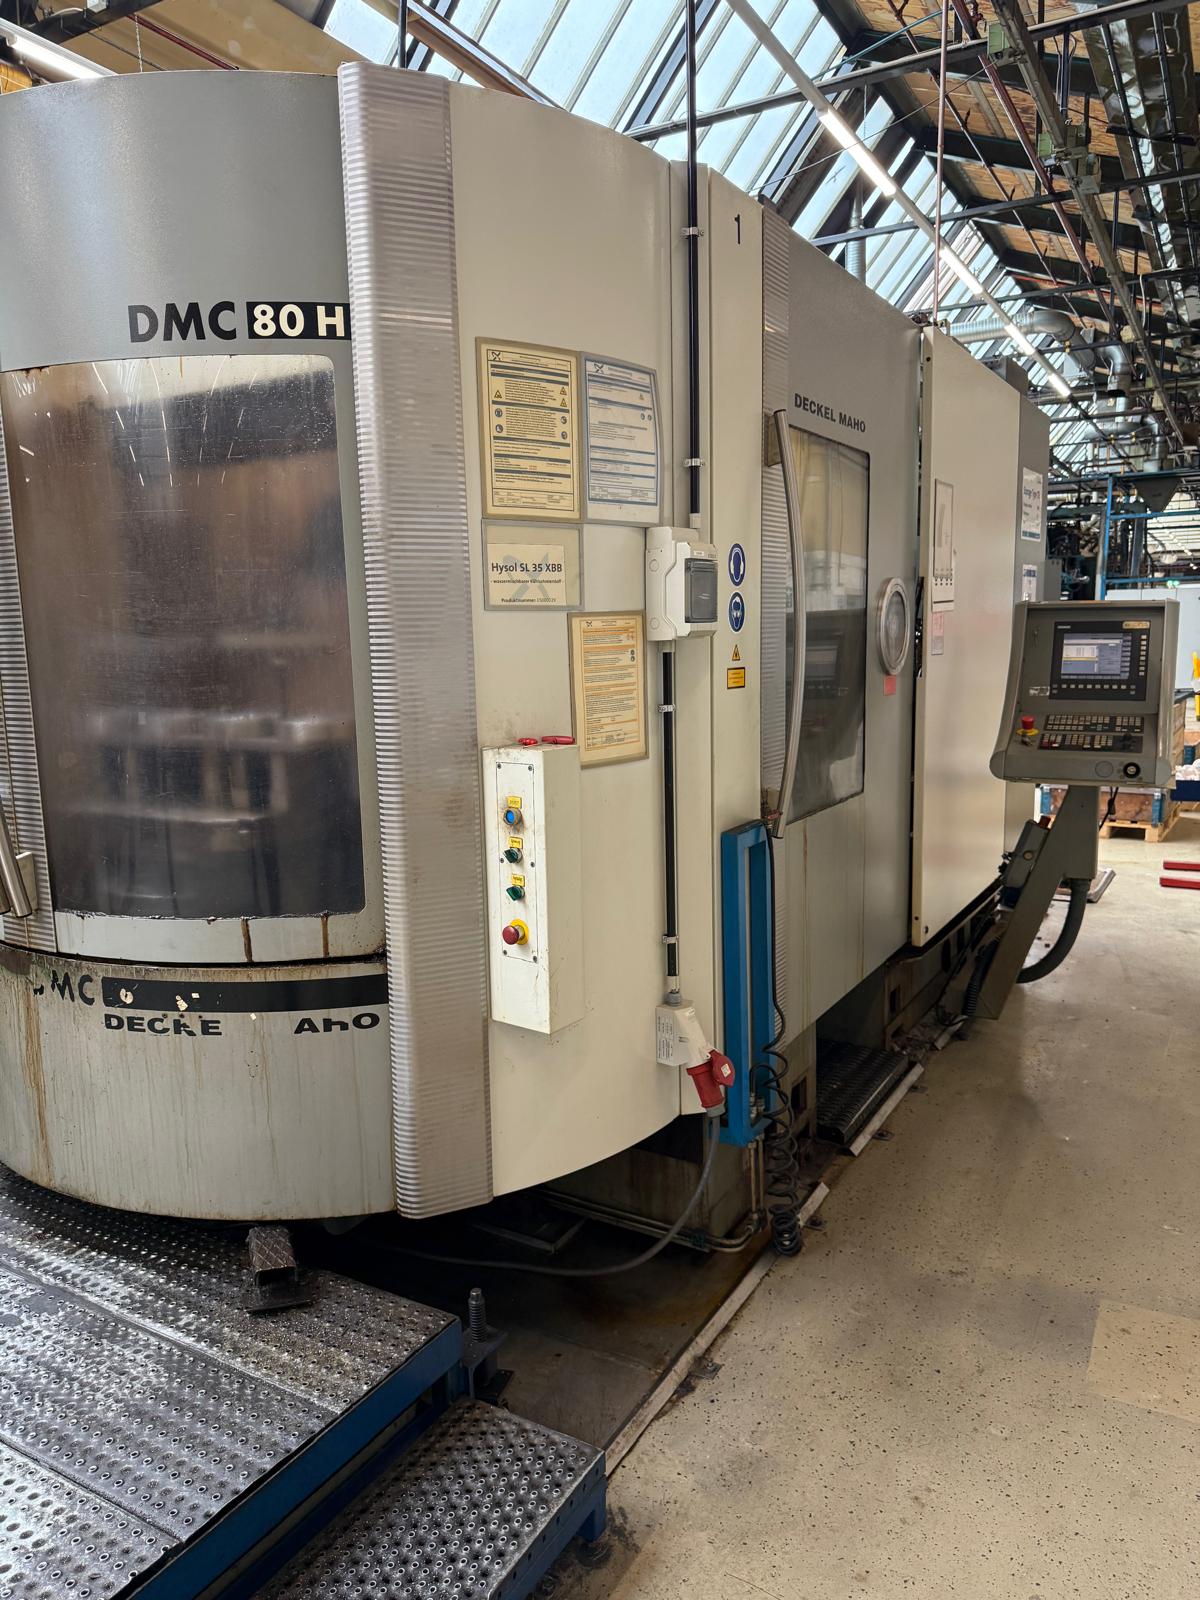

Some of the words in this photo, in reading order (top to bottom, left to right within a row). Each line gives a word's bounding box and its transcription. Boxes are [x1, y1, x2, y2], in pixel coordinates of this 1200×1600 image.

[734, 213, 741, 245] 1
[128, 301, 237, 343] DMC
[794, 392, 837, 423] DECKEL
[838, 411, 866, 433] MAHO
[491, 563, 517, 574] Hysol
[519, 563, 530, 572] SL
[531, 563, 543, 572] 35
[544, 563, 563, 573] XBB
